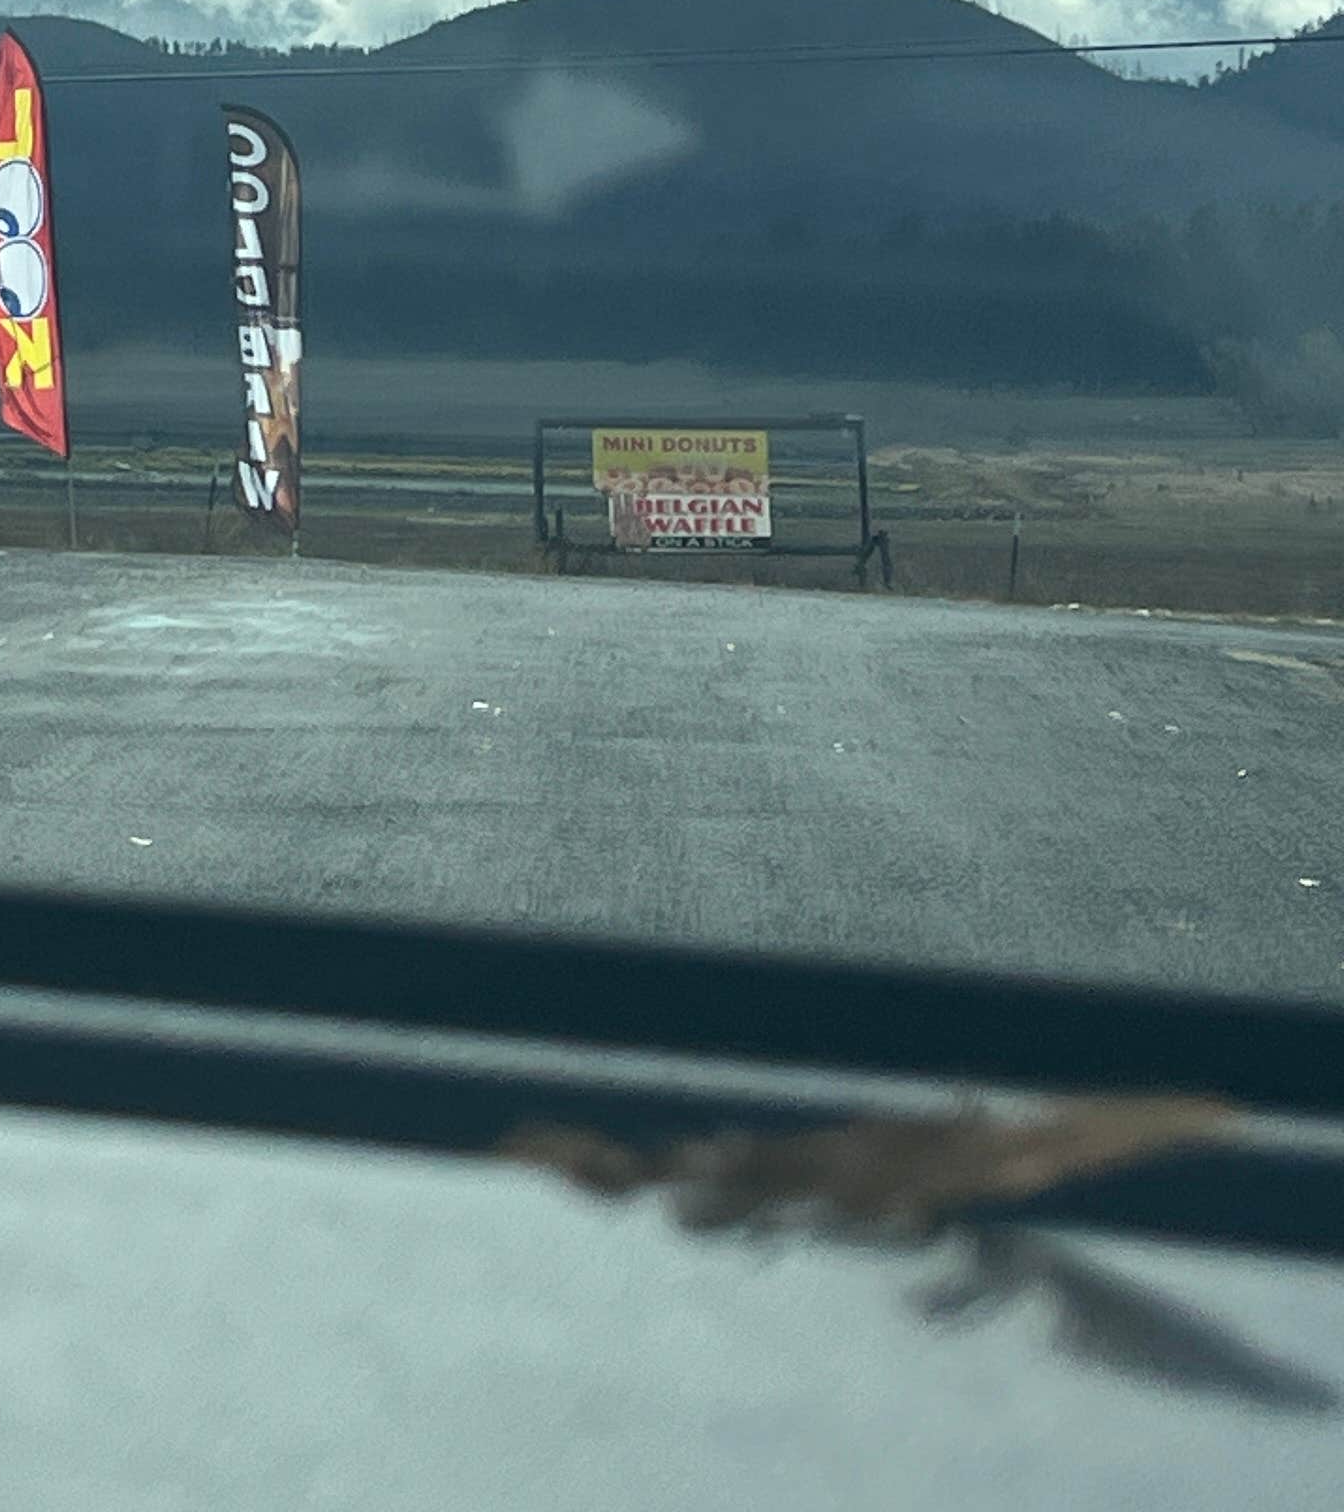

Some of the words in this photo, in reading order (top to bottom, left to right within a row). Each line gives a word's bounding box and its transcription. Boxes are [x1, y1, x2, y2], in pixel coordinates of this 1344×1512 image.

[602, 437, 653, 453] MINI
[662, 437, 757, 454] DONUTS
[636, 499, 763, 515] BELGIAN
[644, 517, 756, 534] WAFFLE
